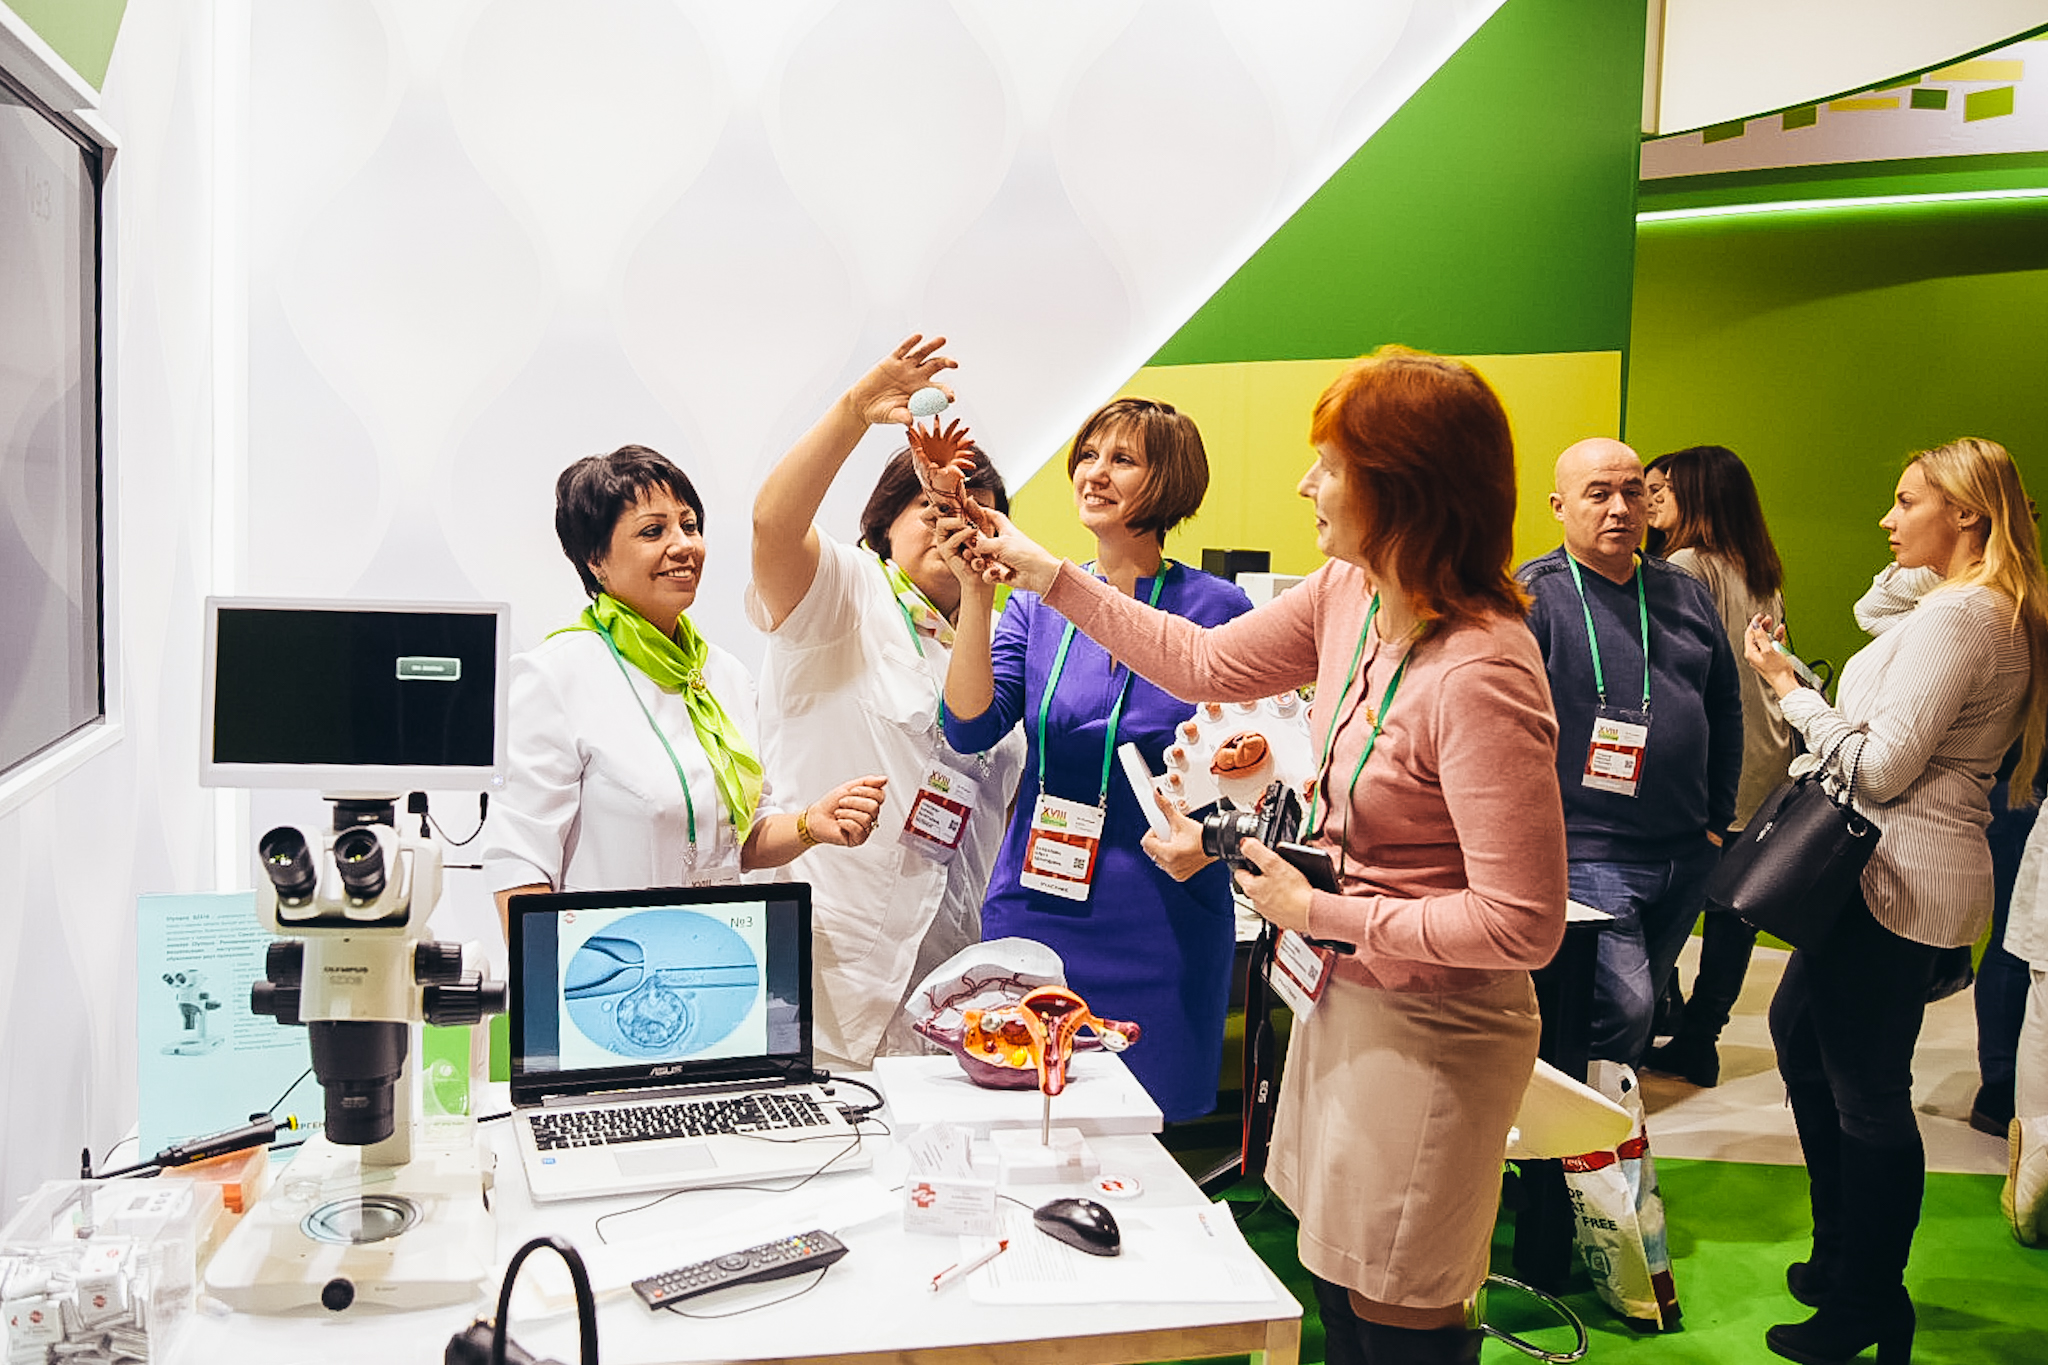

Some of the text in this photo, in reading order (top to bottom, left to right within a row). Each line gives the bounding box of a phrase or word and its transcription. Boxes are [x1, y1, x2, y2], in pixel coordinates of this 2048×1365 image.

[1042, 806, 1067, 820] XVIII
[730, 915, 754, 929] №3
[649, 1065, 684, 1077] ASUS
[1257, 1079, 1269, 1104] EOS
[1581, 1216, 1618, 1231] FREE
